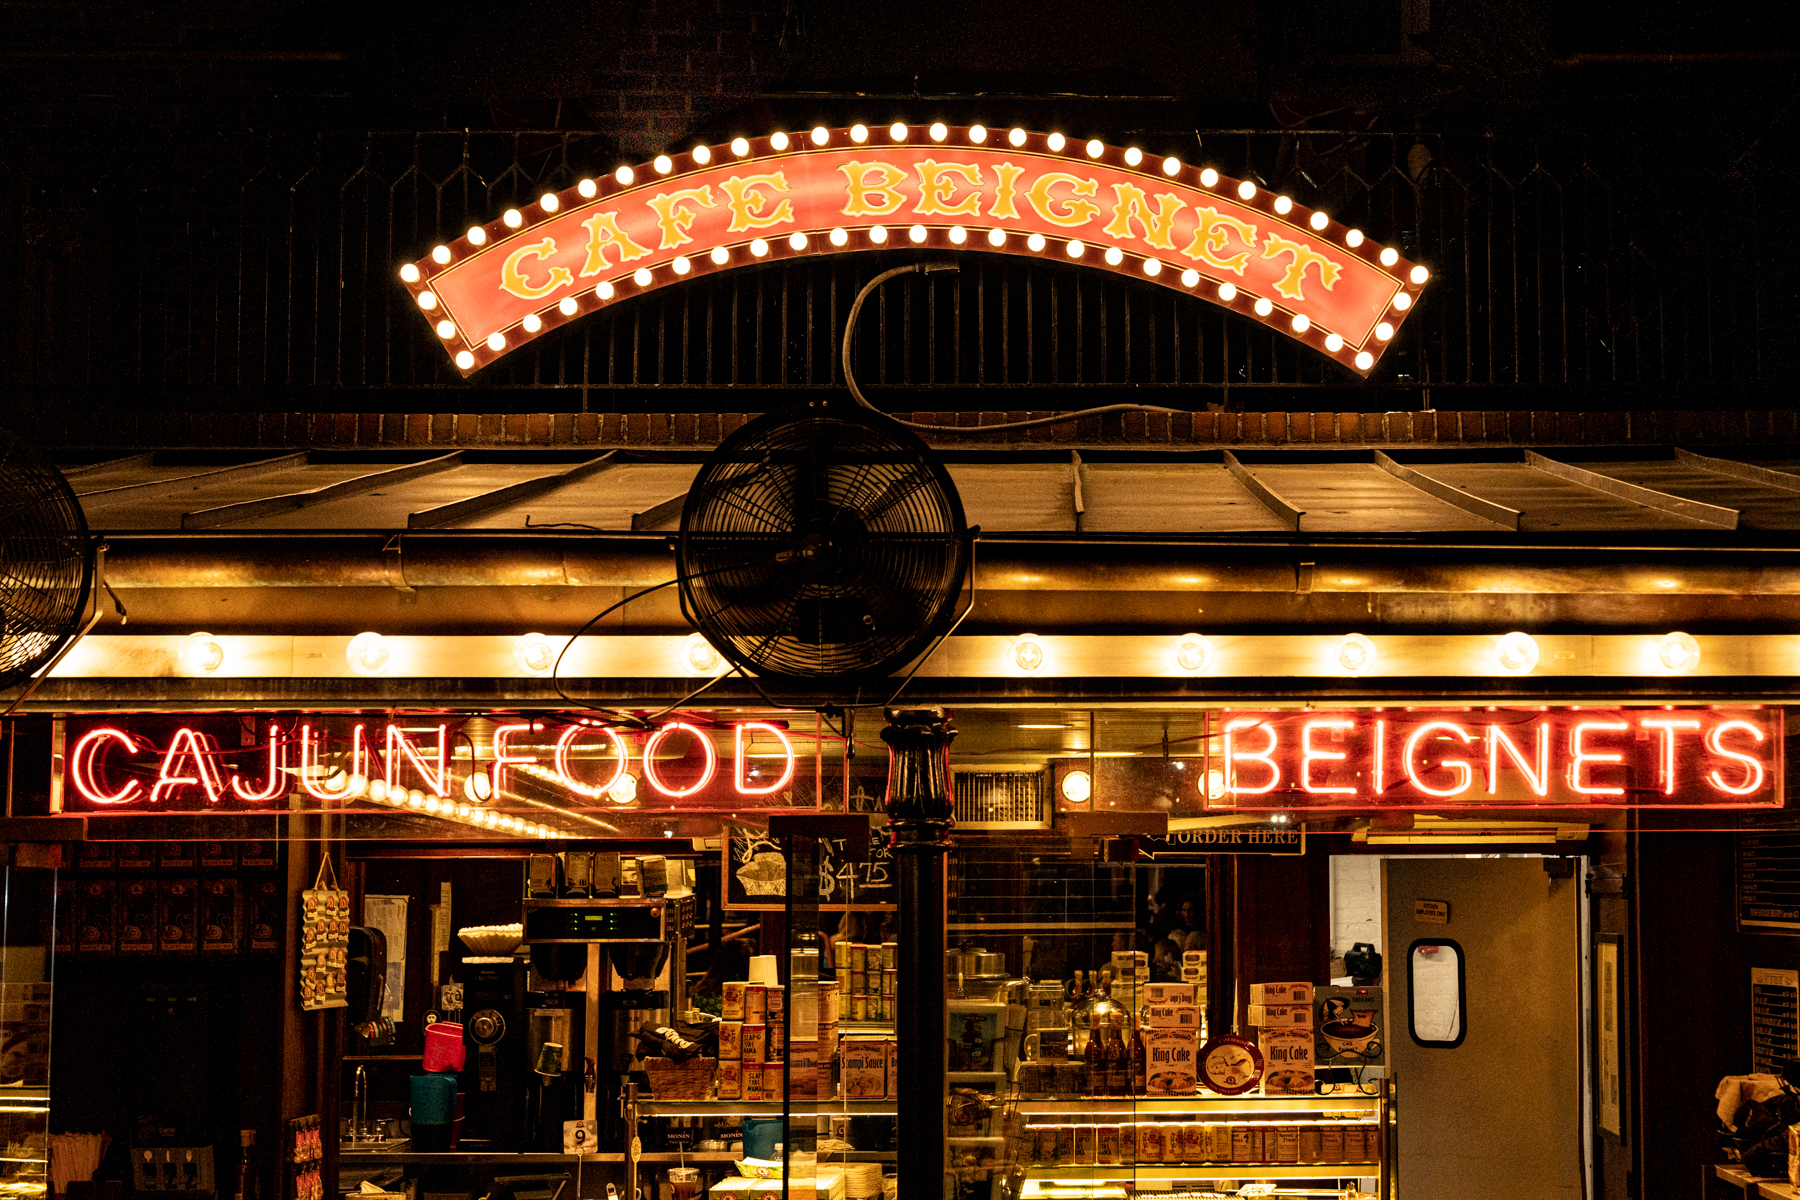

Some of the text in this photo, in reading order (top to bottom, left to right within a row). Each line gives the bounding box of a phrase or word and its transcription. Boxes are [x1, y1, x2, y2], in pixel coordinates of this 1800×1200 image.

[498, 159, 1342, 302] CAFE BEIGNET
[70, 720, 796, 804] CAJUN FOOD
[1222, 719, 1766, 797] BEIGNETS
[1178, 829, 1298, 845] ORDER HERE
[1275, 985, 1287, 994] Cake
[1162, 1008, 1173, 1016] Cake
[1277, 1007, 1288, 1016] Cake
[1152, 1047, 1191, 1063] King Cake
[1270, 1045, 1308, 1062] King Cake
[865, 1056, 883, 1069] Sauce
[574, 1129, 586, 1144] 9
[720, 1131, 743, 1139] MONIN
